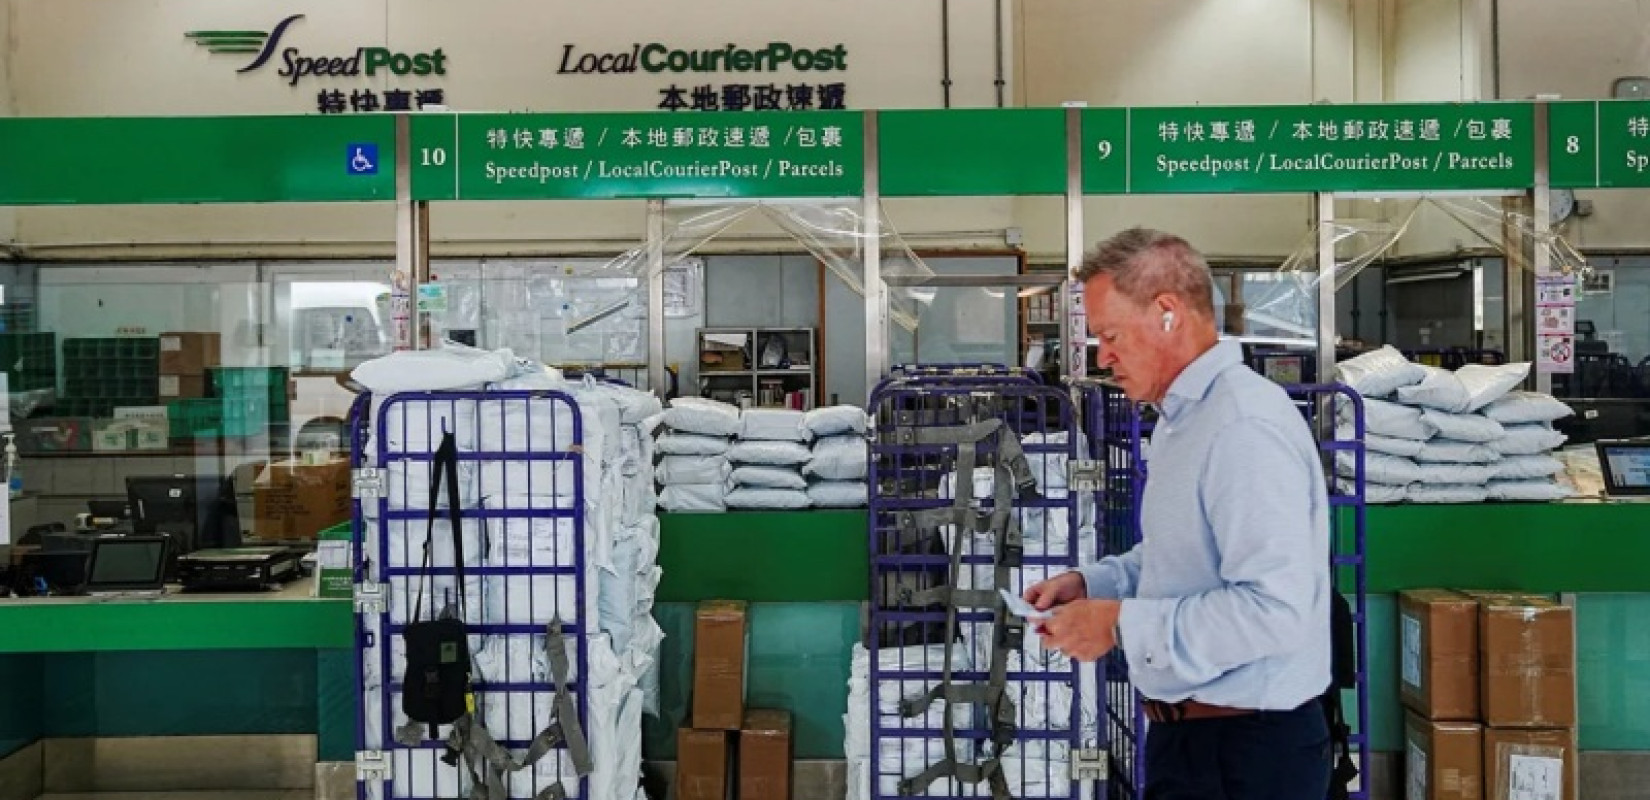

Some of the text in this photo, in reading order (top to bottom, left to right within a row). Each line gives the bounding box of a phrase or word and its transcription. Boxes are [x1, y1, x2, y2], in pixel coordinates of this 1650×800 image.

[277, 46, 447, 87] SpeedPost
[486, 127, 585, 149] 特快專遞
[620, 125, 770, 148] 本地郵政速遞
[1158, 119, 1255, 143] 特快專遞
[1292, 118, 1441, 141] 本地郵政速遞
[420, 147, 447, 166] 10
[1098, 139, 1113, 160] 9
[1565, 135, 1580, 155] 8
[485, 160, 579, 184] Speedpost
[598, 159, 758, 178] LocalCourierPost
[778, 159, 845, 177] Parcels
[1156, 153, 1250, 178] Speedpost
[1269, 152, 1428, 171] LocalCourierPost
[1447, 151, 1514, 171] Parcels
